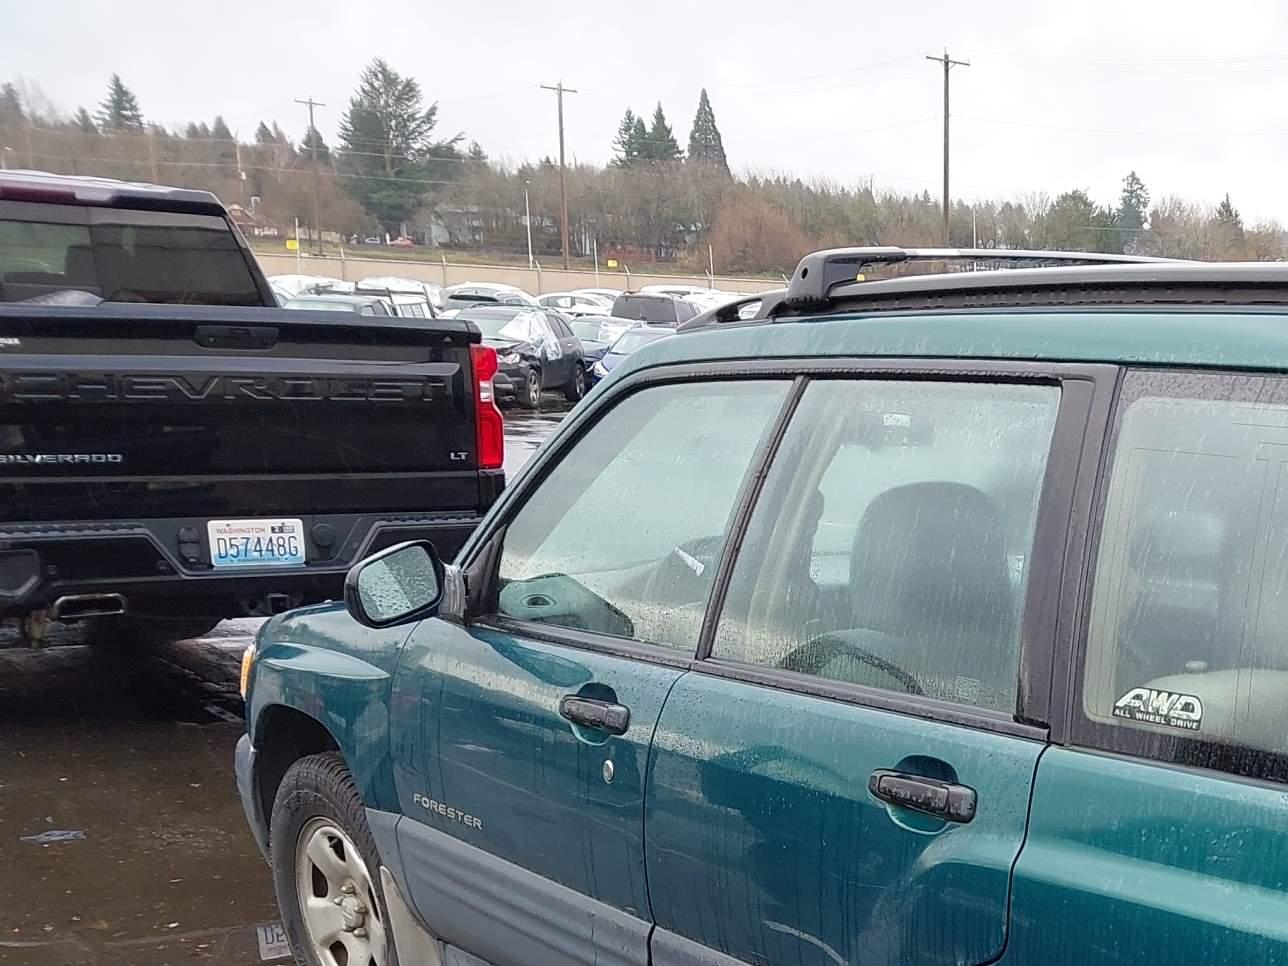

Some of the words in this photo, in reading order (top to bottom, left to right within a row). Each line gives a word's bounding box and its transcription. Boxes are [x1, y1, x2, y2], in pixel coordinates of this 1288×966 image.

[13, 373, 446, 401] CHEVROLET
[450, 451, 469, 462] LT
[216, 535, 299, 559] D57448G
[1114, 687, 1202, 720] AWD
[1113, 708, 1131, 718] ALL
[1136, 711, 1166, 724] WHEEL
[1170, 719, 1199, 729] DRIVE
[413, 792, 482, 830] FORESTER
